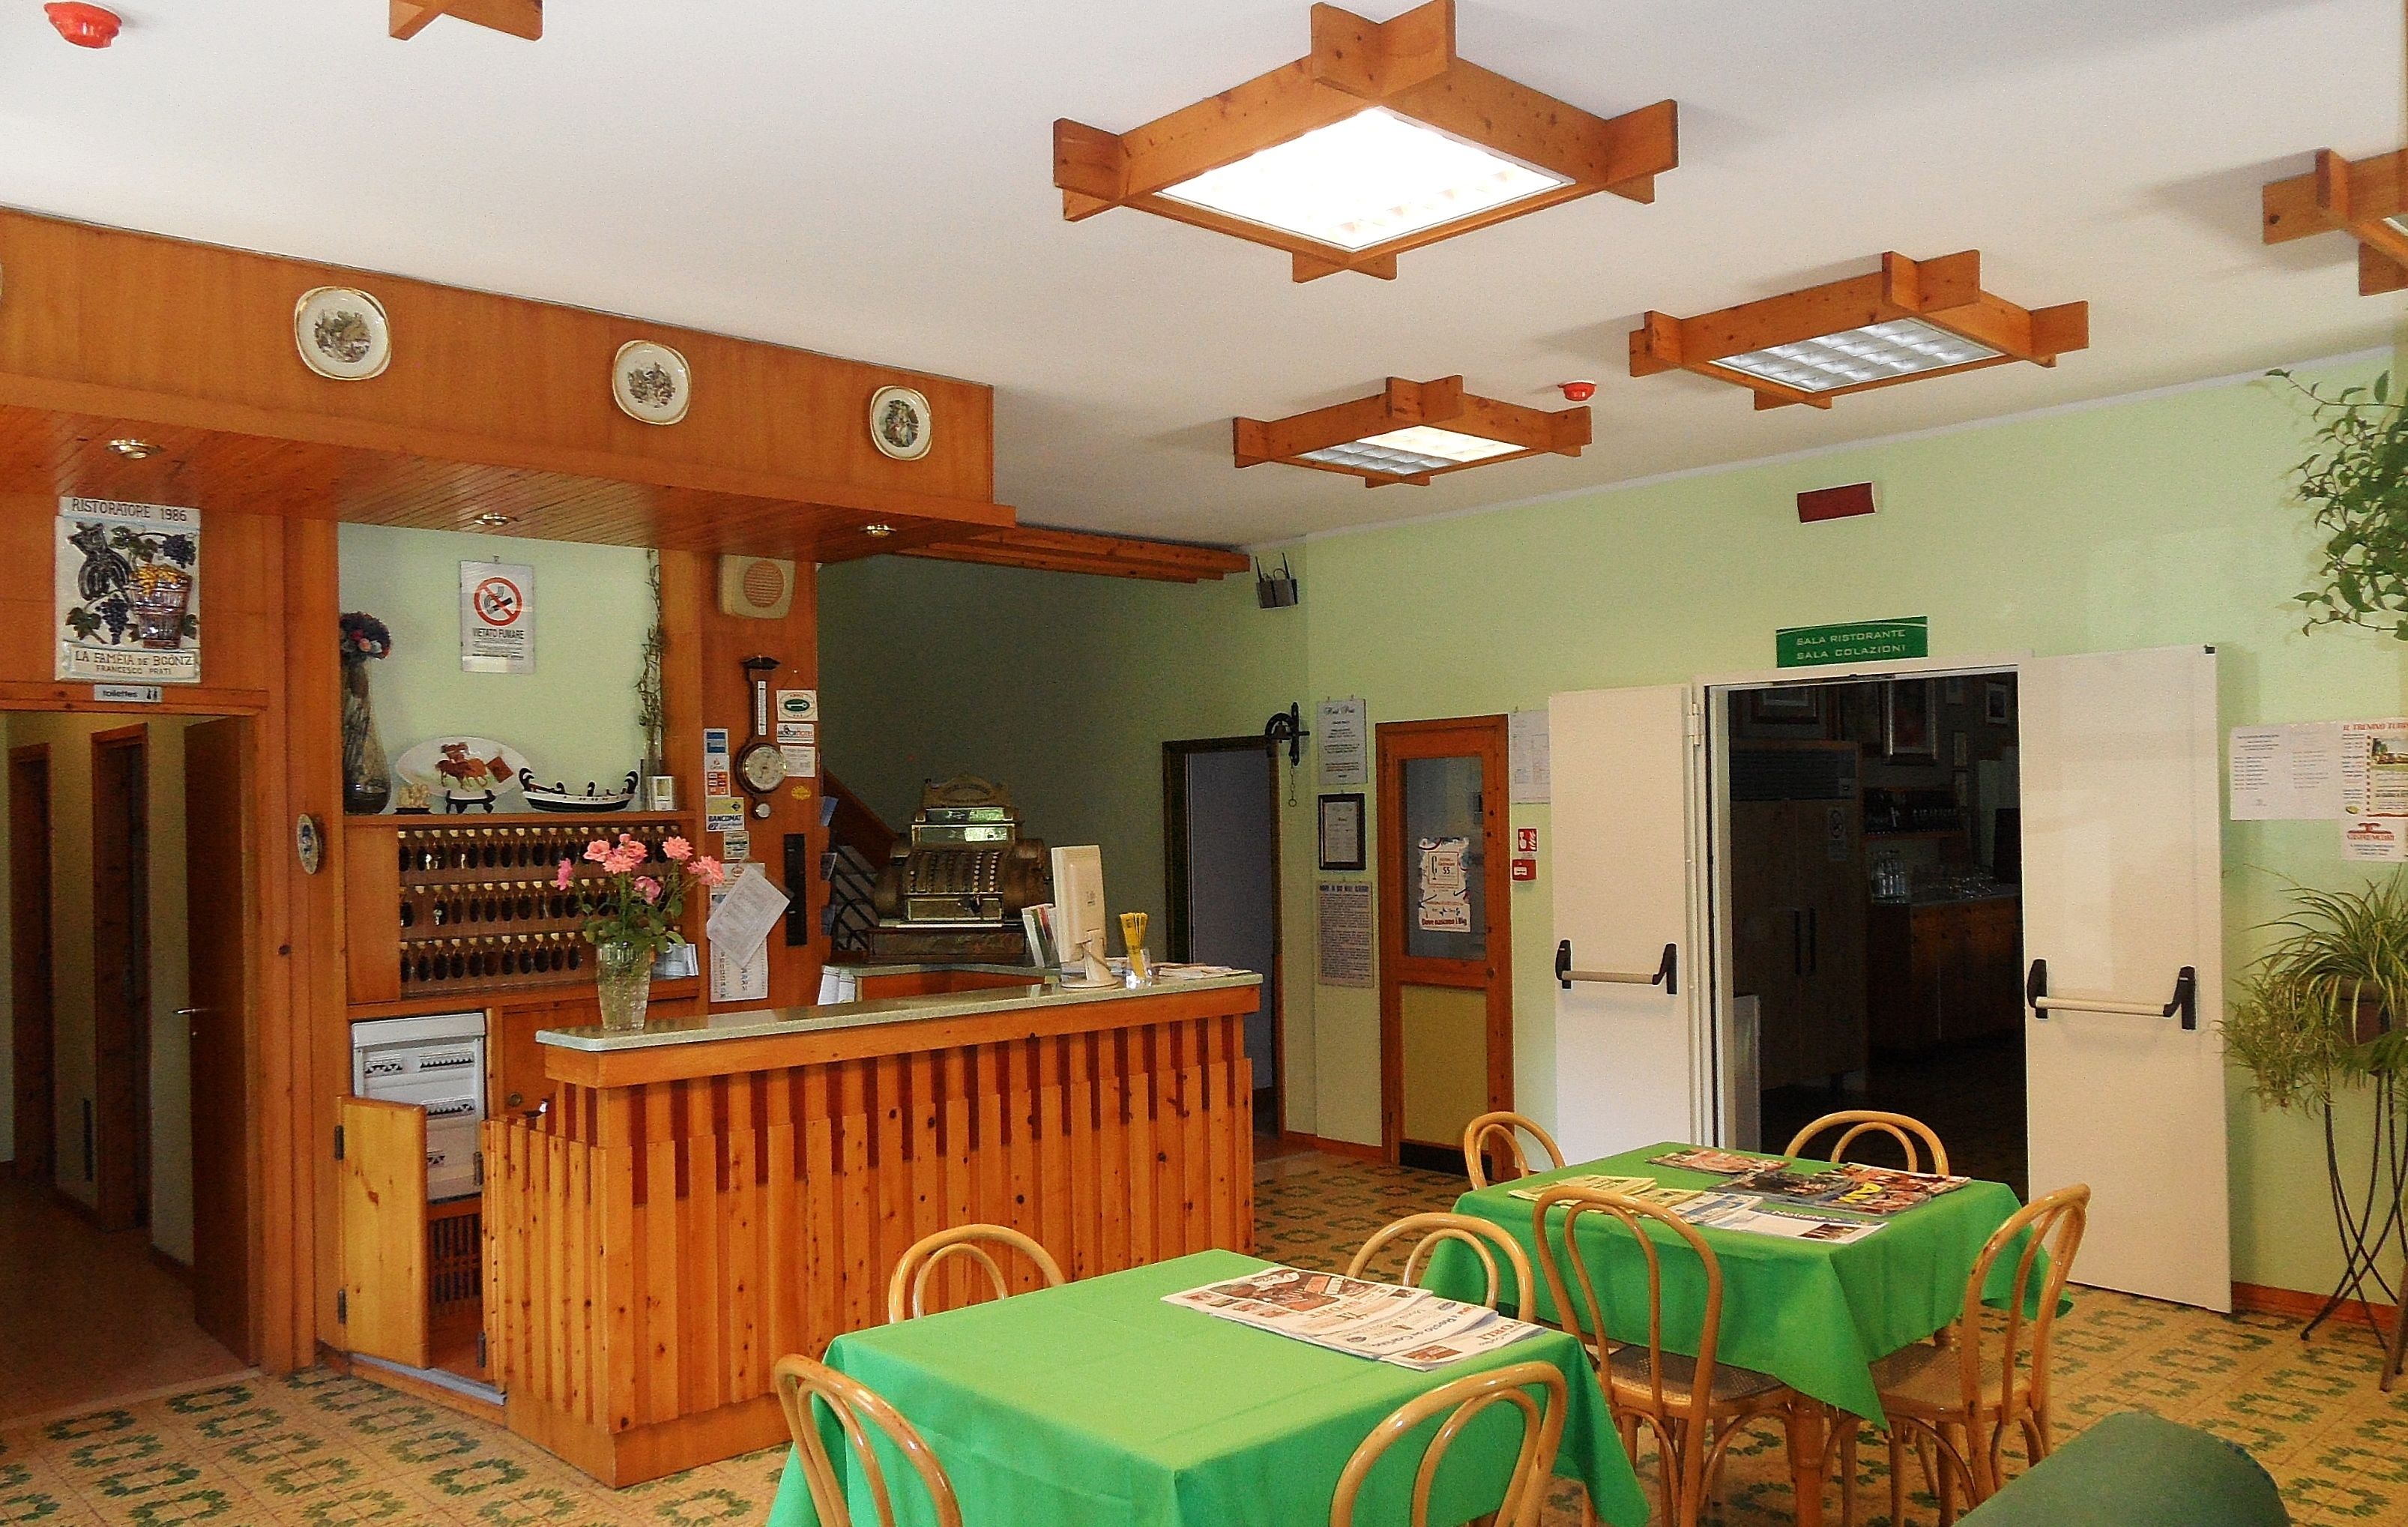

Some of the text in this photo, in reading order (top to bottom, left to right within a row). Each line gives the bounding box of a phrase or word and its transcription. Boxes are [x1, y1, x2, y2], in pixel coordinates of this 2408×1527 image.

[72, 499, 187, 522] RISTORATORE 1986
[1796, 630, 1906, 645] SALA RISTORANTE
[75, 650, 90, 662] LA
[1796, 644, 1906, 660] SALA COLAZIONI
[96, 664, 142, 674] FRANCESCO
[103, 689, 139, 698] toilettes
[707, 814, 742, 822] BANCOMAT
